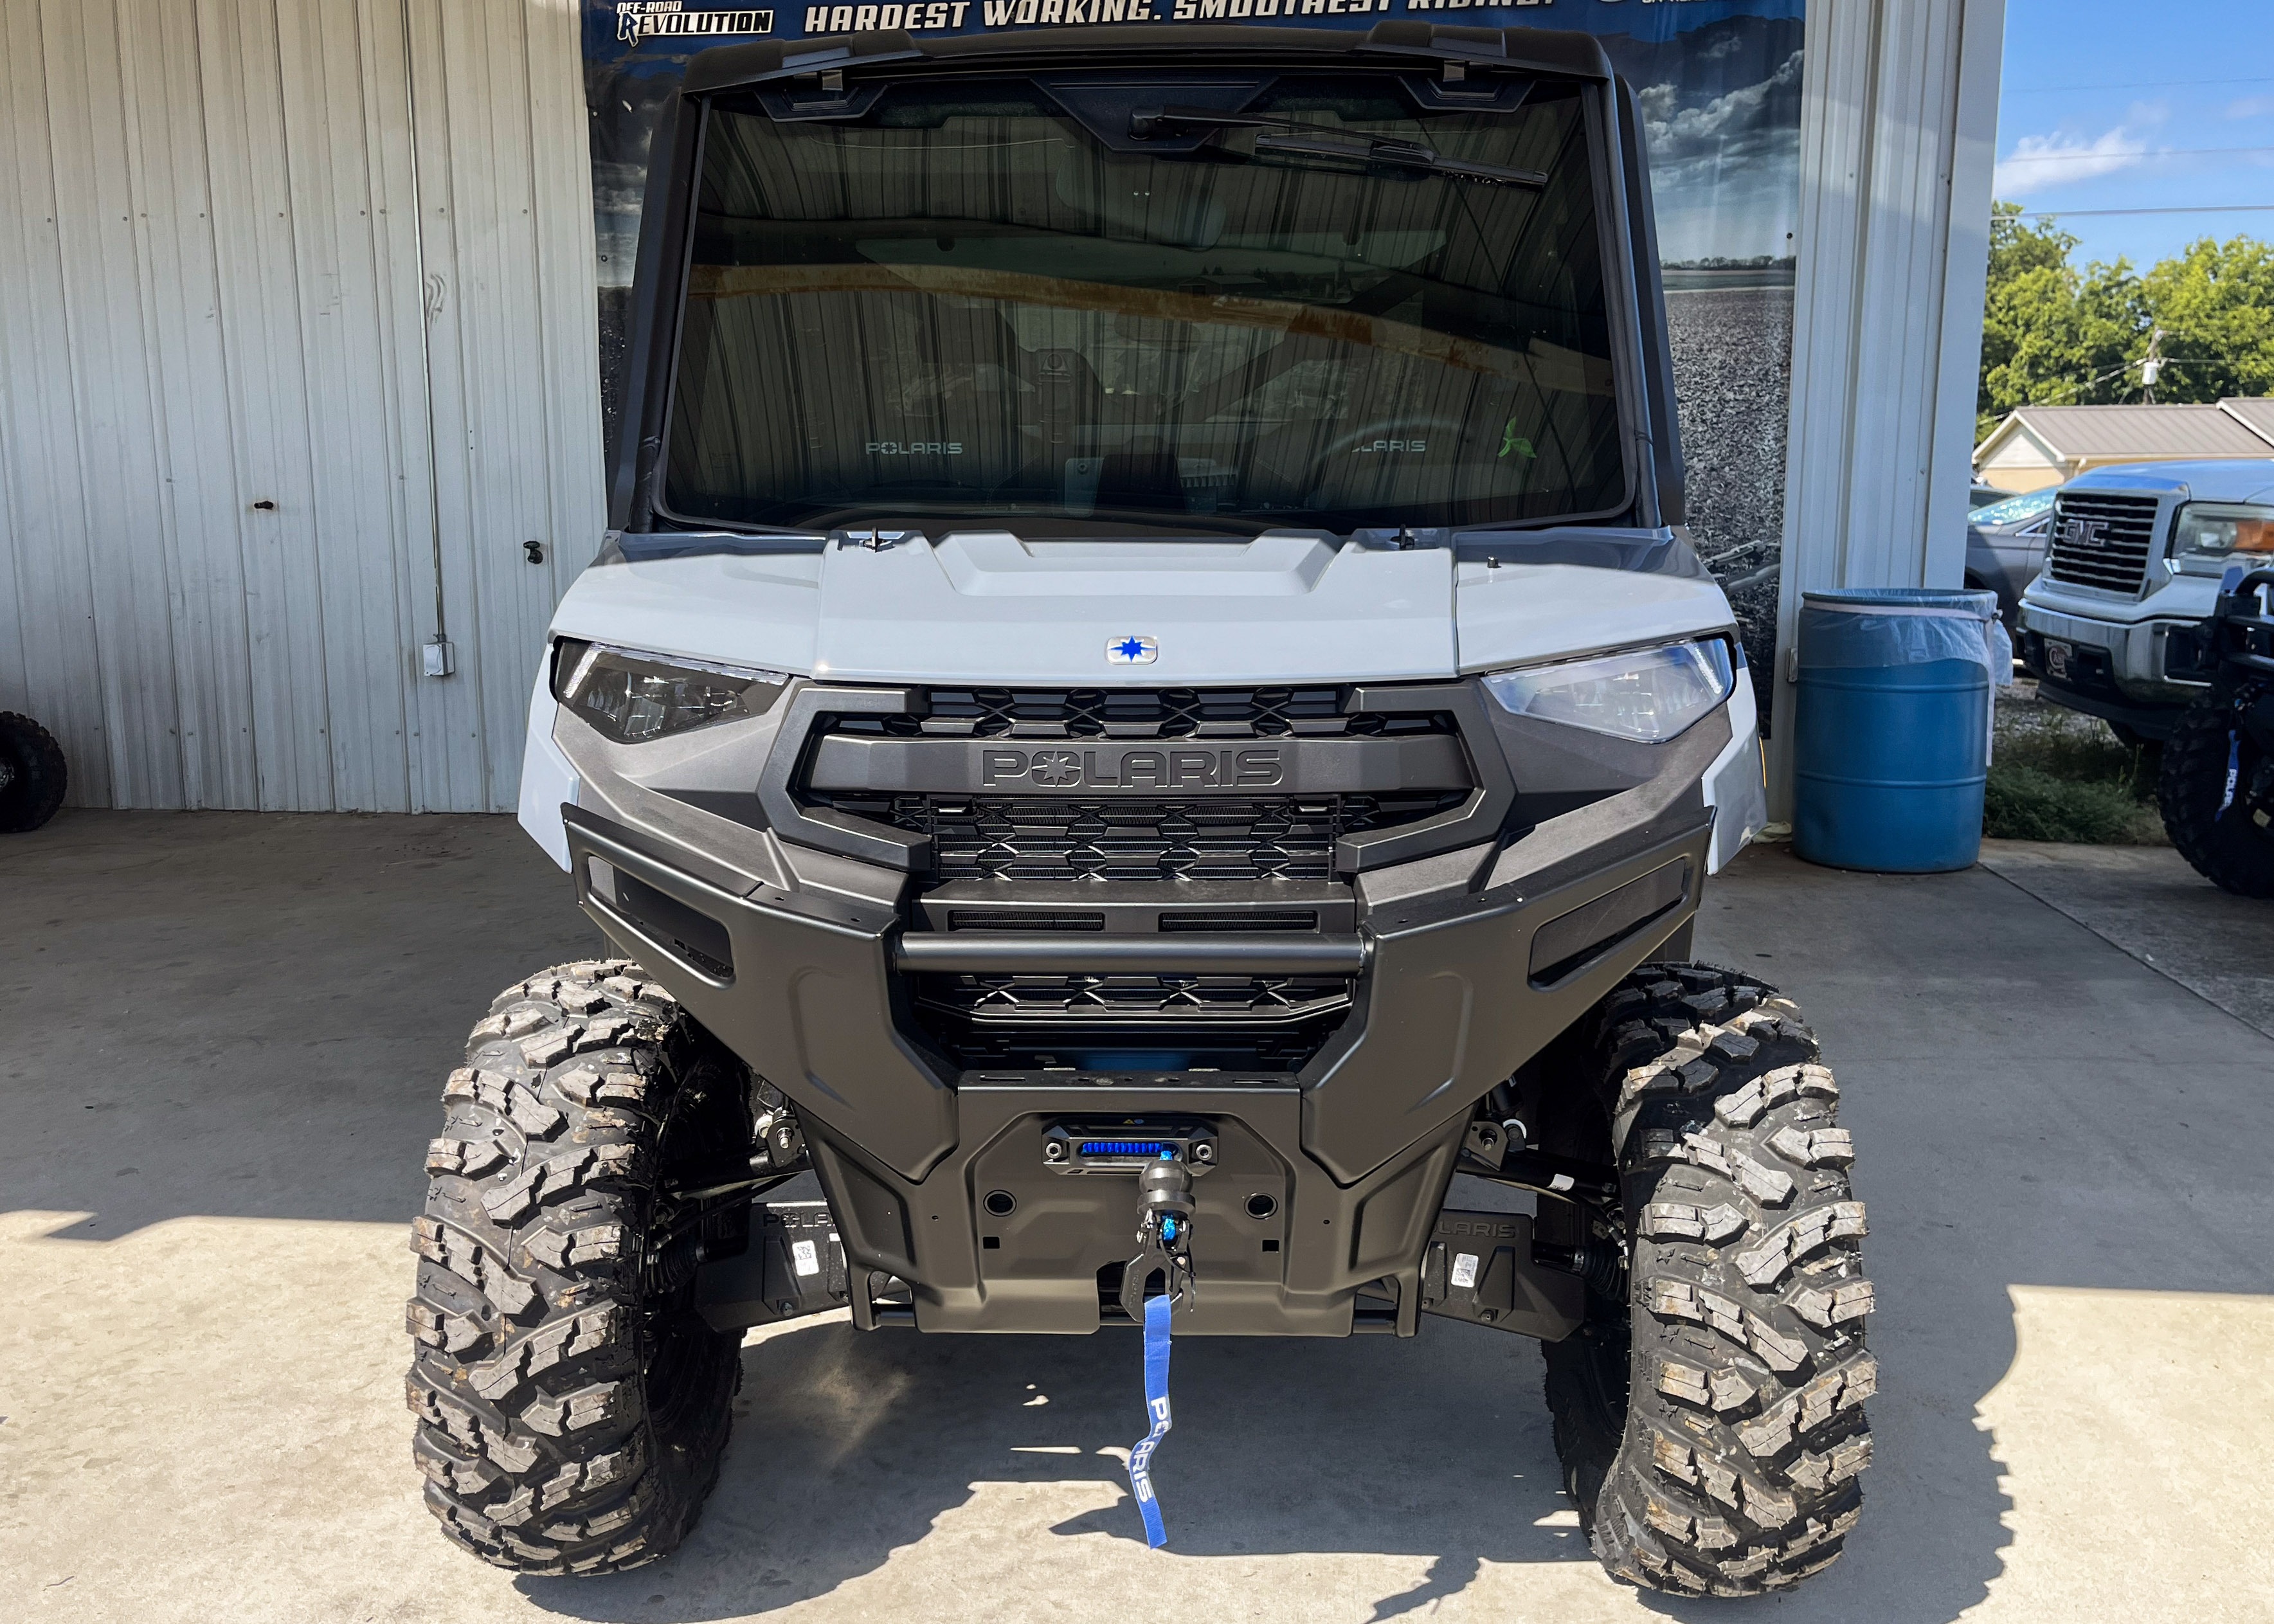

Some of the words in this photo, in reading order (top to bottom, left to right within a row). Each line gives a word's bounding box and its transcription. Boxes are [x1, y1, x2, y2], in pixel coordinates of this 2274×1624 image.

[617, 1, 682, 14] OFF-ROAD
[805, 2, 971, 32] HARDEST
[984, 0, 1161, 26] WORKING.
[617, 11, 772, 47] REVOLUTION
[865, 442, 963, 455] POLARIS
[2062, 519, 2109, 547] GMC
[982, 750, 1284, 788] POLARIS
[763, 1212, 835, 1228] POLA
[1434, 1220, 1516, 1238] LARIS
